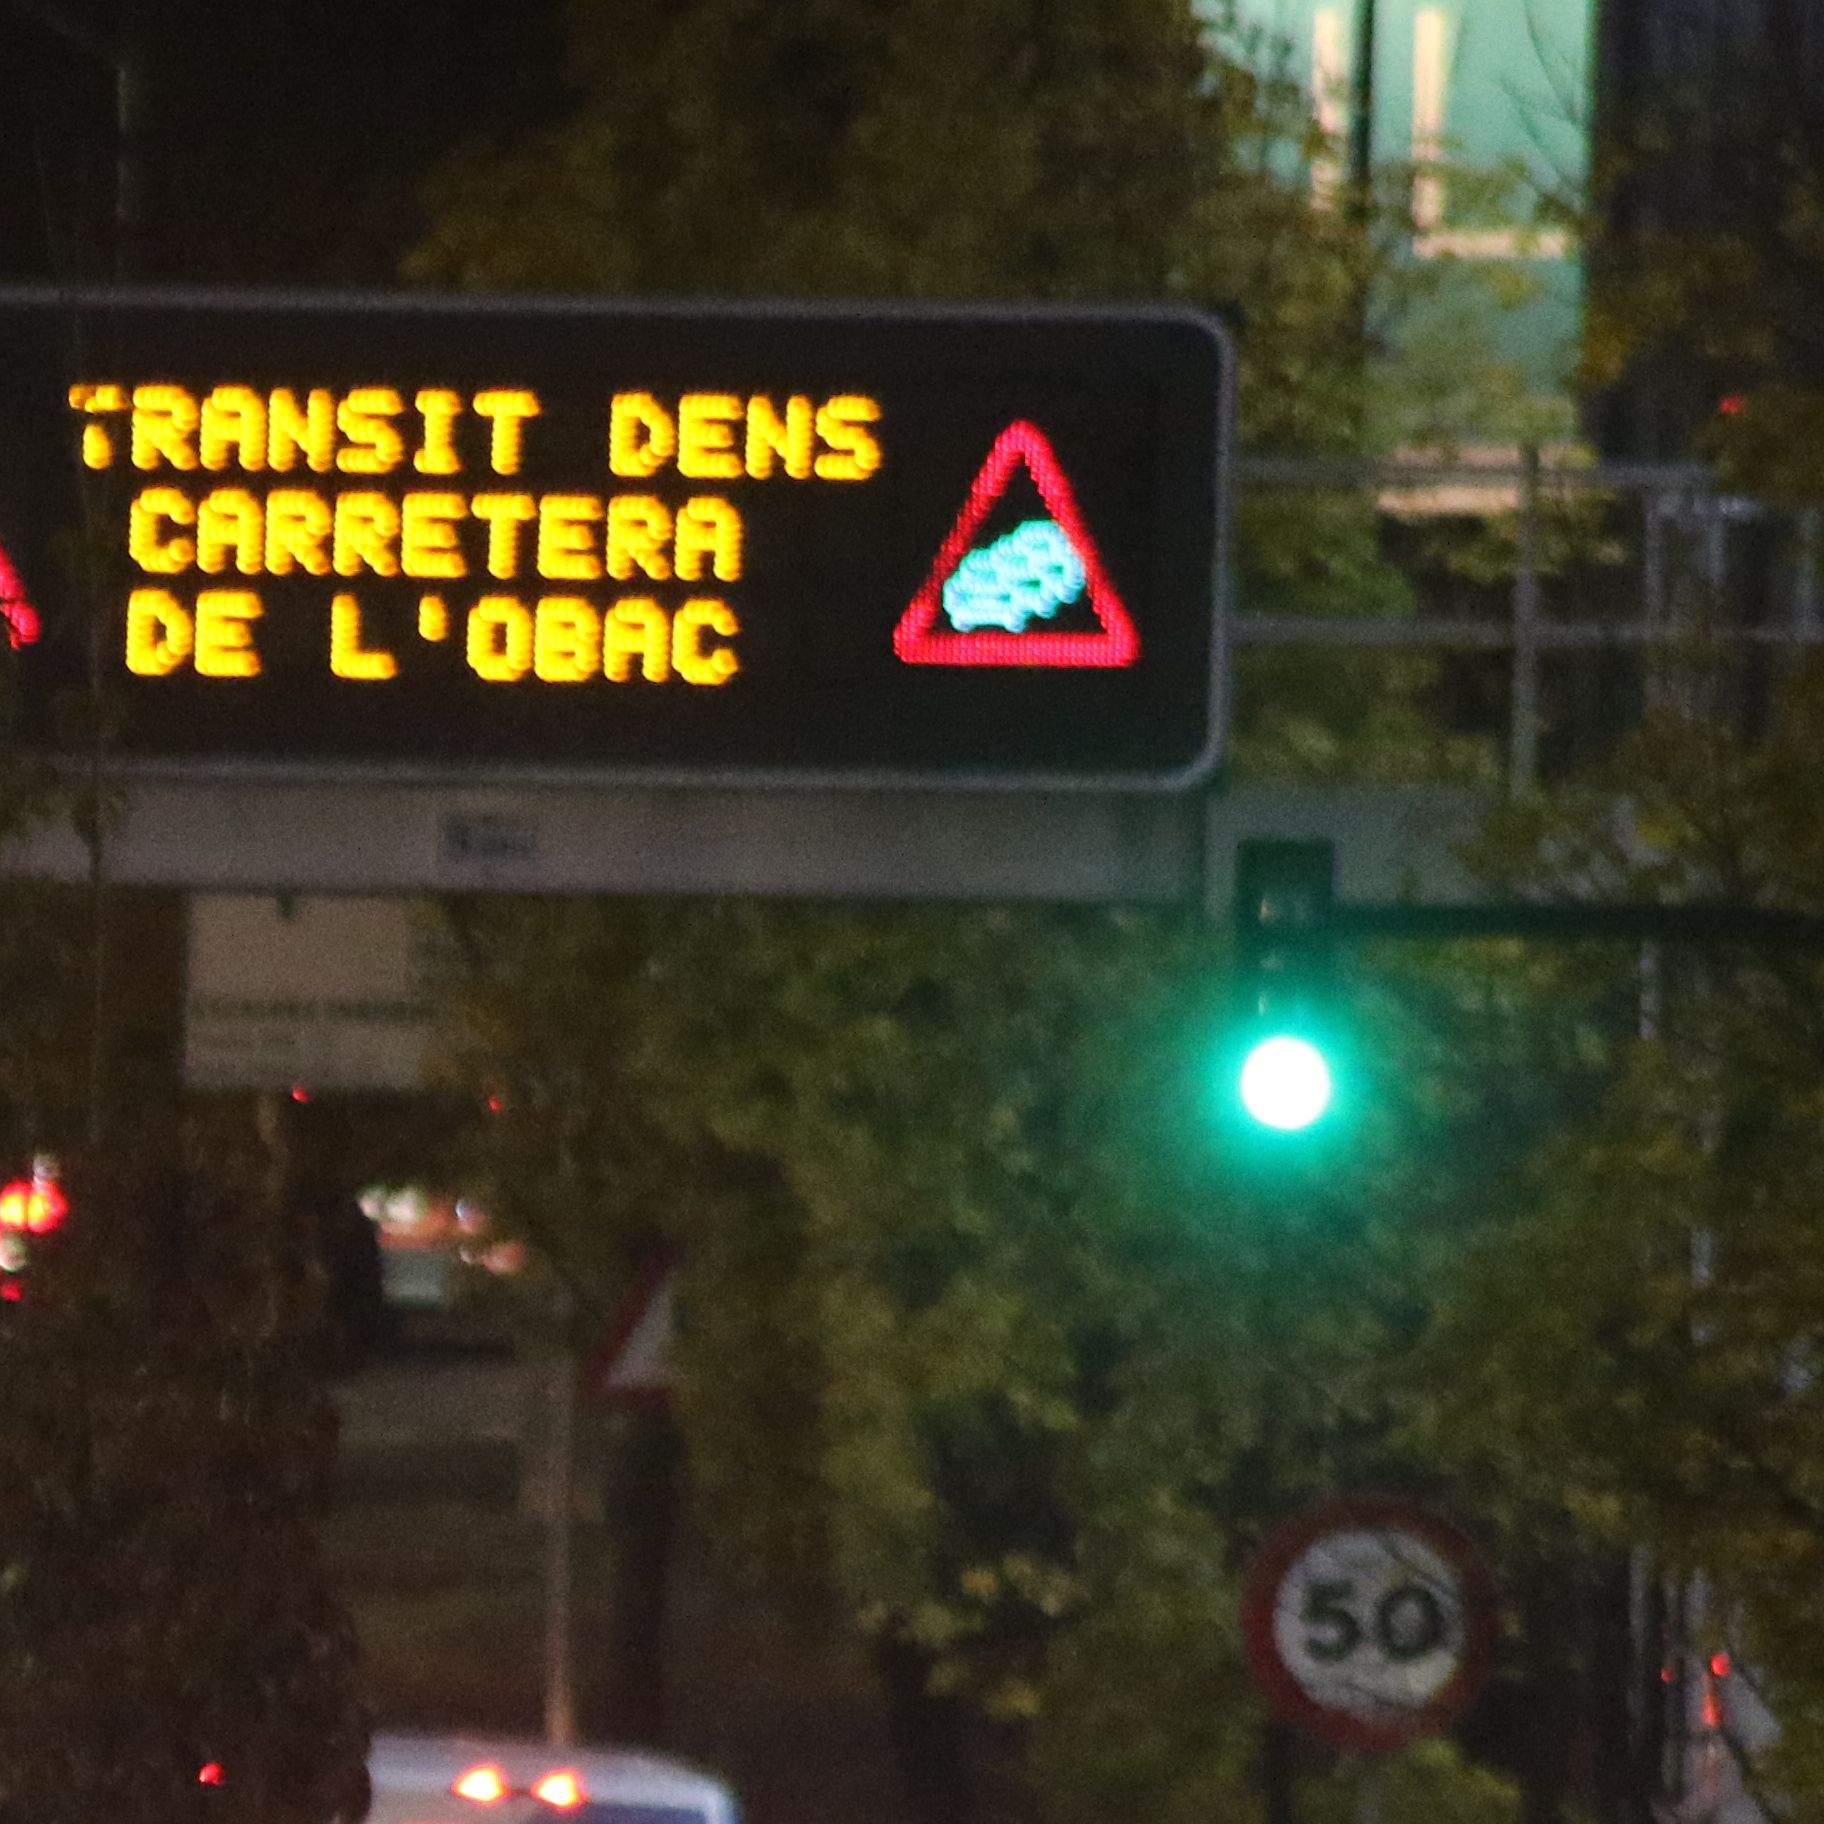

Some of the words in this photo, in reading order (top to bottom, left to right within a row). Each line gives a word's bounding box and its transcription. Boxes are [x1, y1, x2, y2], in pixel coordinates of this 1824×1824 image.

[68, 384, 540, 480] TRANSIT
[608, 391, 883, 481] DENS
[128, 488, 743, 582] CARRETERA
[125, 588, 263, 678] DE
[330, 594, 739, 686] L'OBAC
[1304, 1579, 1446, 1662] 50
